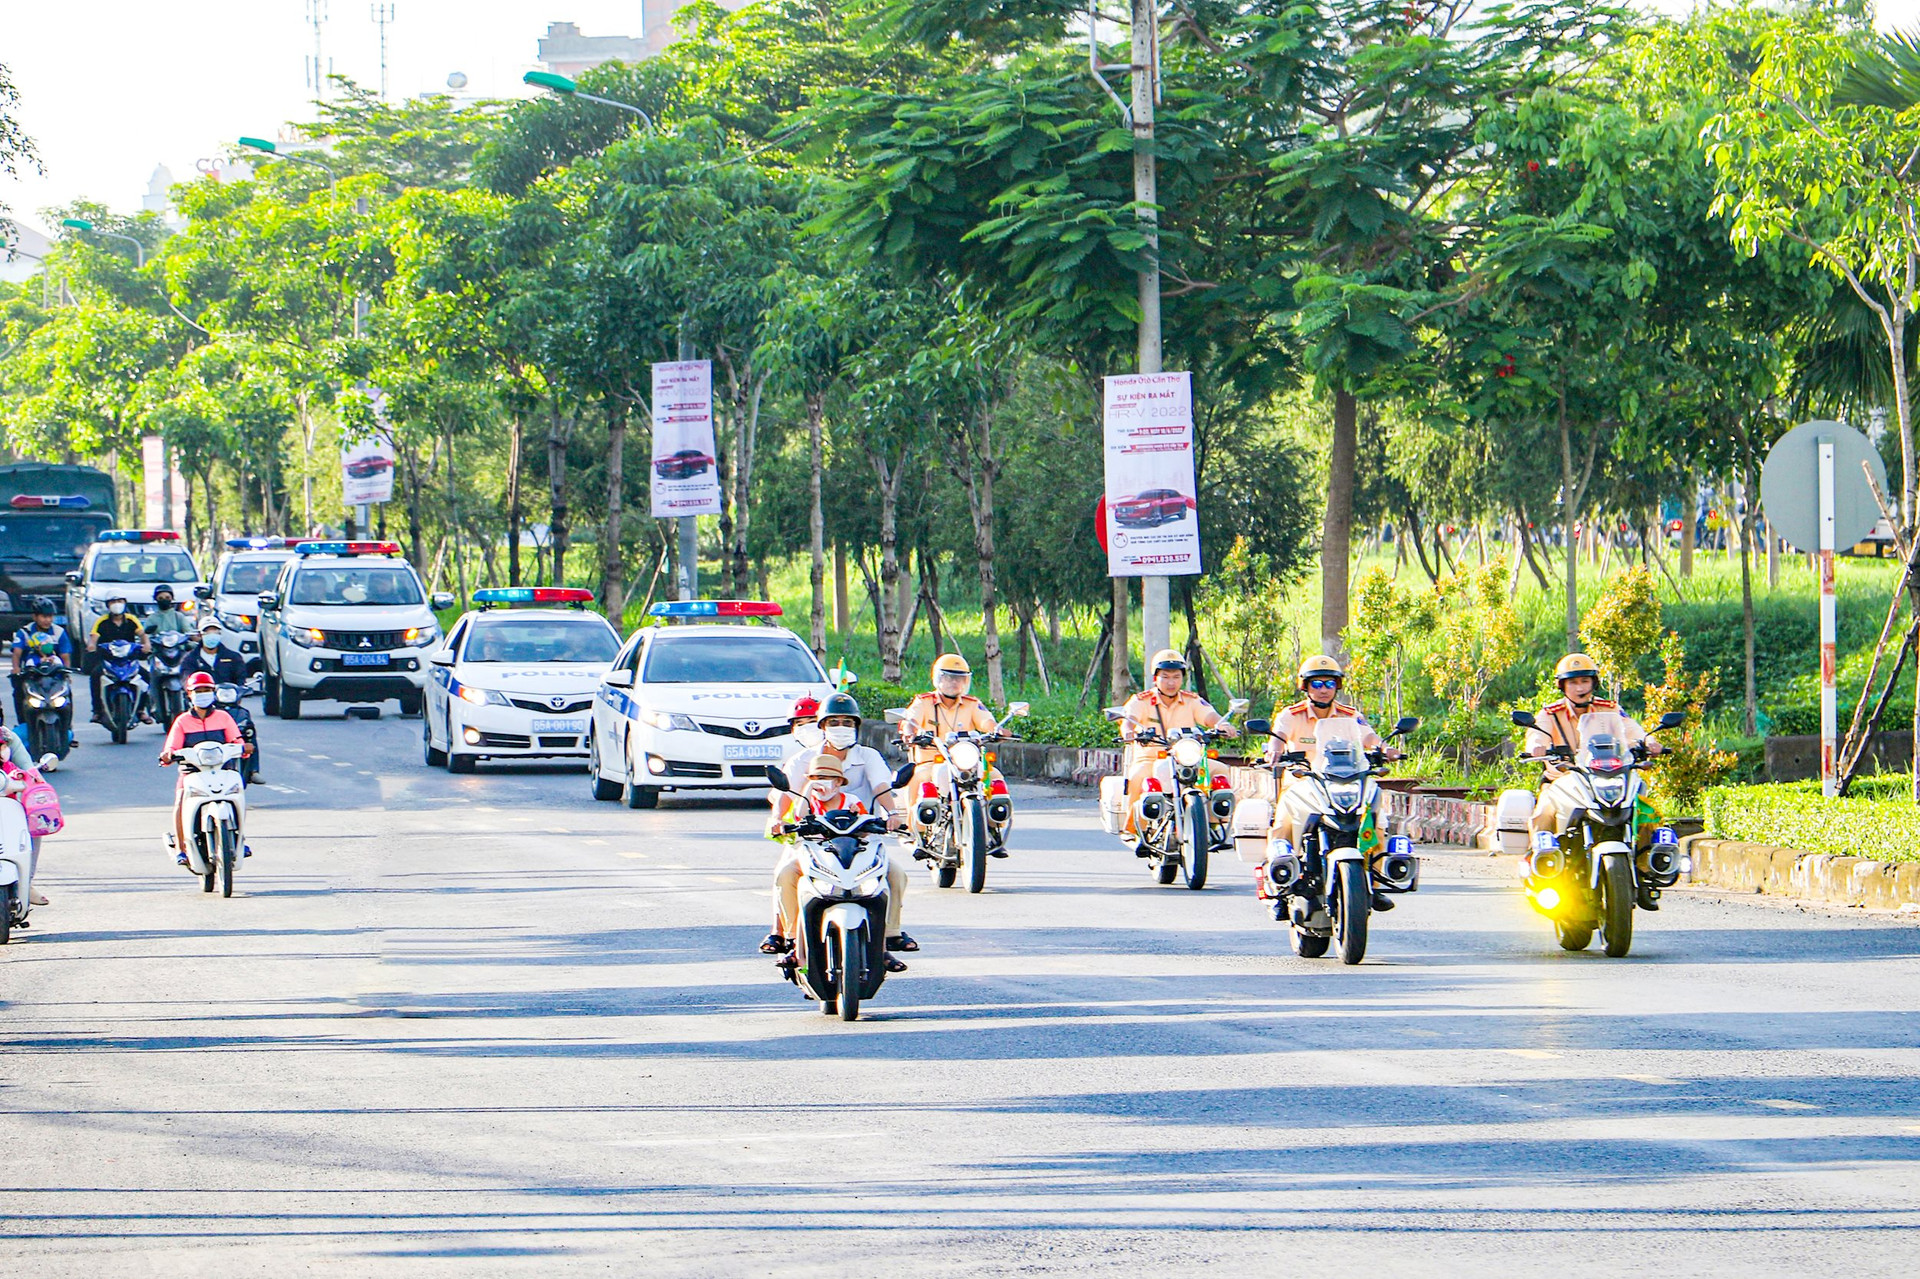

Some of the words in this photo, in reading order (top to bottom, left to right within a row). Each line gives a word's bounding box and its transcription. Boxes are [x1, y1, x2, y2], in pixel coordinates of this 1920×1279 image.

[1113, 378, 1137, 386] Honda
[1108, 408, 1145, 419] HR-V
[1151, 406, 1187, 418] 2022
[691, 692, 799, 700] POLICE
